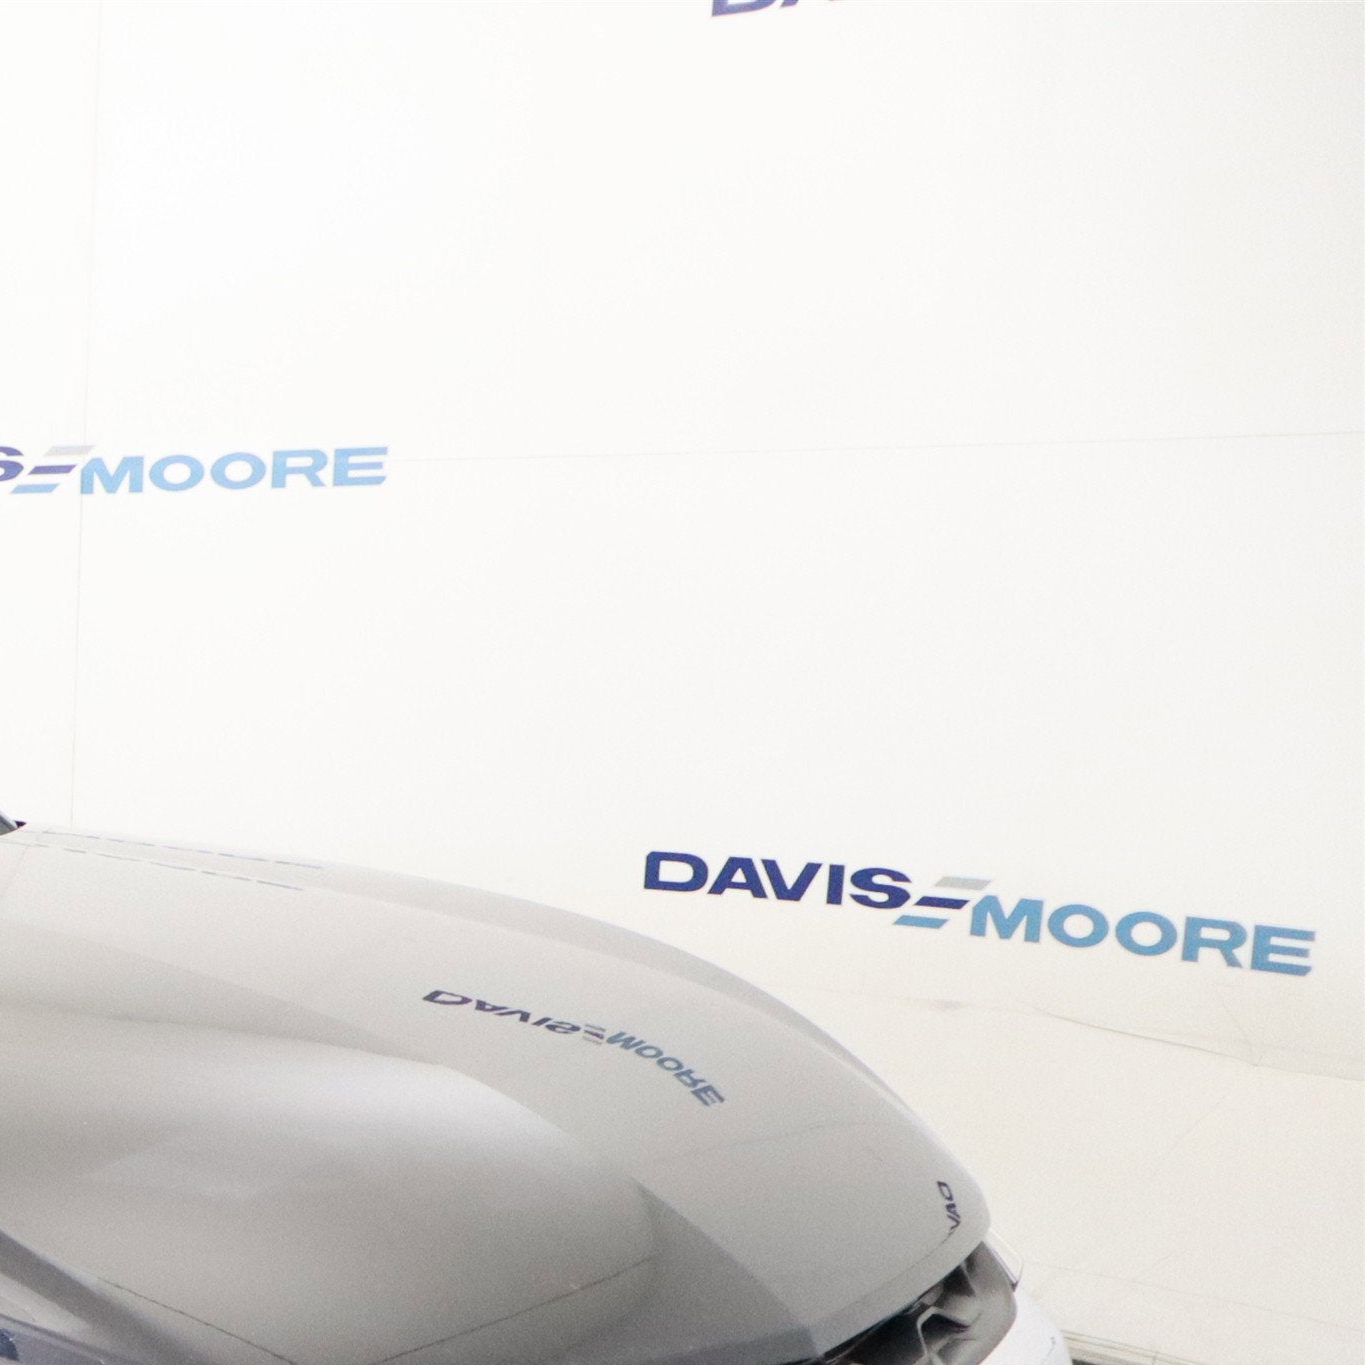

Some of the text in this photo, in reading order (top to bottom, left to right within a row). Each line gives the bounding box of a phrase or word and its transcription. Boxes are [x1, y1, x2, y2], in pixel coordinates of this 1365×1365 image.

[80, 446, 388, 496] MOORE
[643, 850, 1317, 978] DAVIS MOORE
